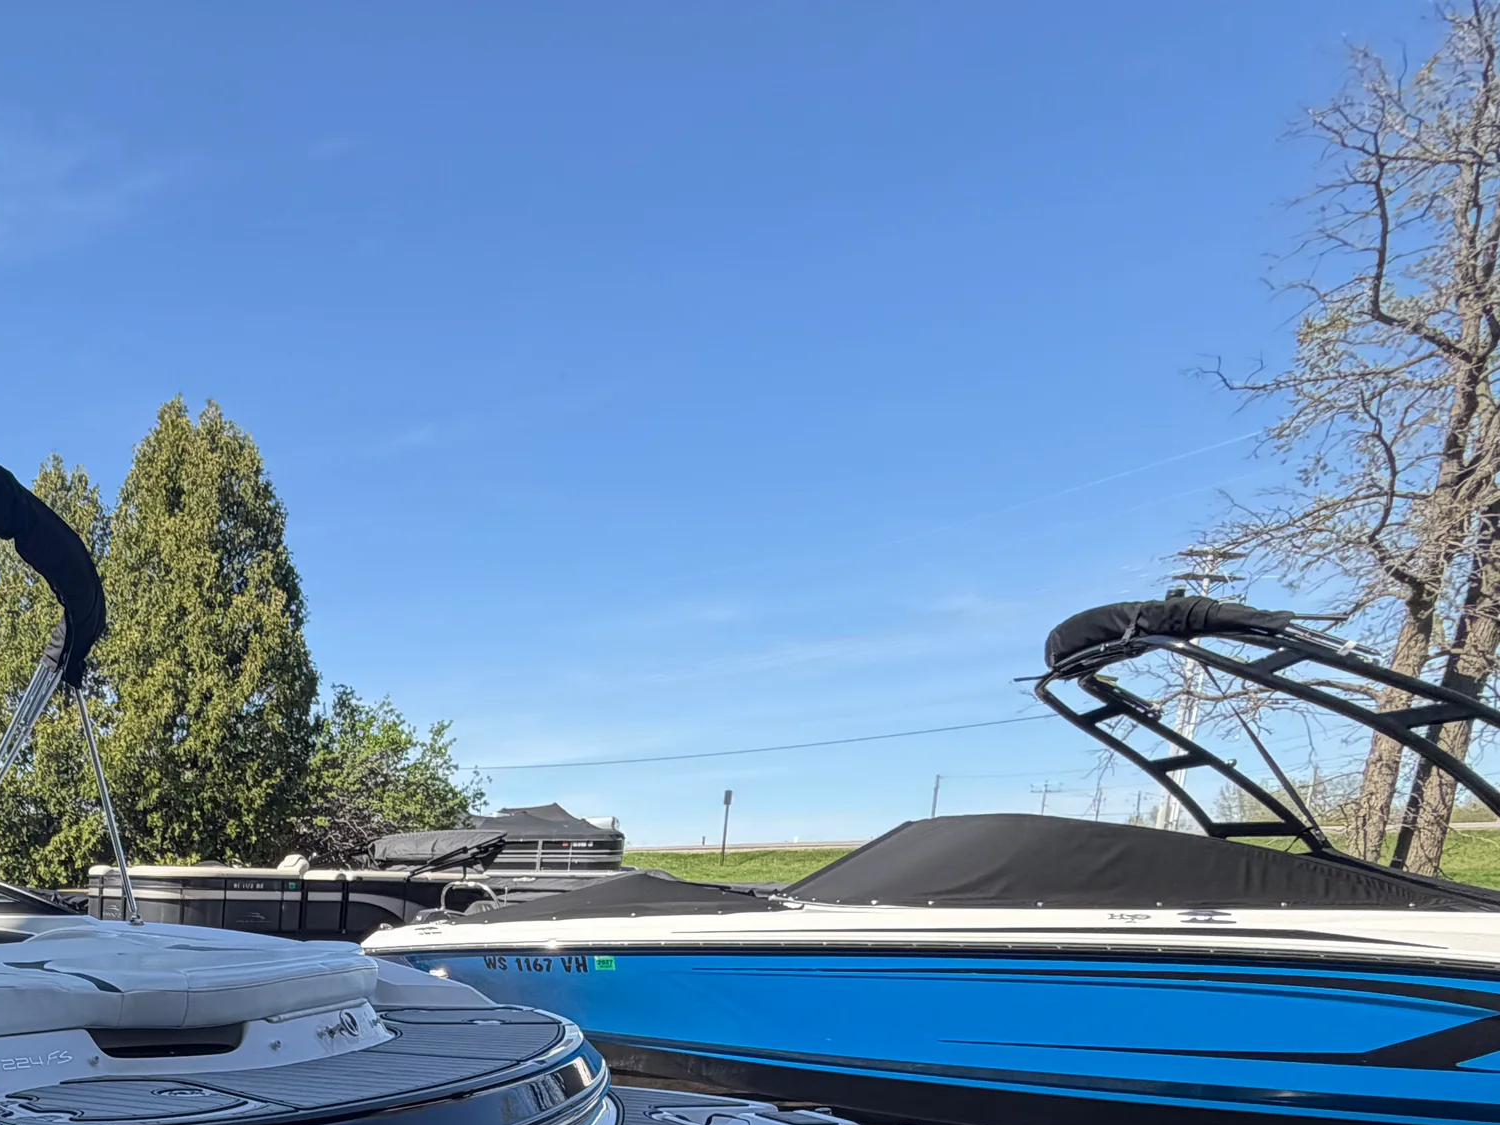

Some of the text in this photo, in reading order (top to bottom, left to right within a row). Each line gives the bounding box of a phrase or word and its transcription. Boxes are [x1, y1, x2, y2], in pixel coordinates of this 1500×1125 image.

[483, 955, 588, 973] WS 1167 VH
